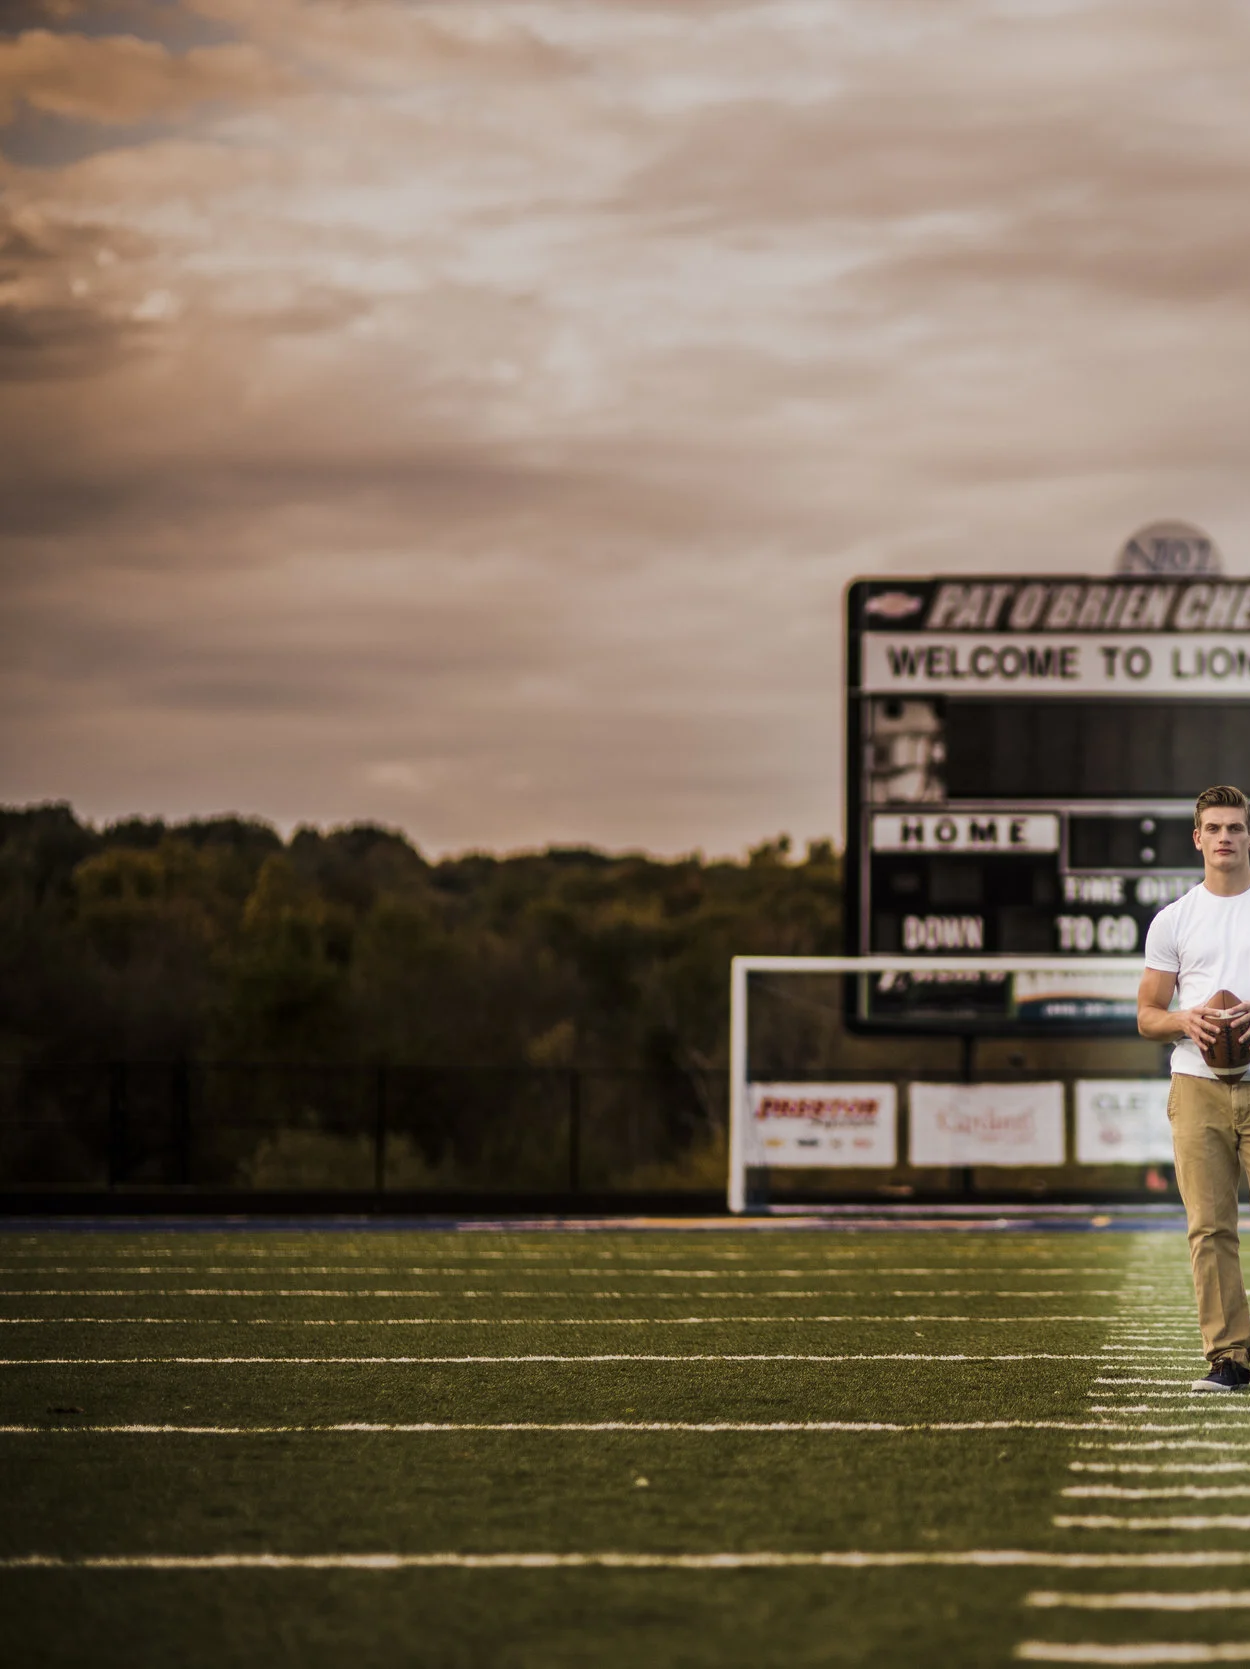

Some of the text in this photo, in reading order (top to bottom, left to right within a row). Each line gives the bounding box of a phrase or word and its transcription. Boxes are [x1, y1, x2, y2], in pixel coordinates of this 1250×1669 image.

[925, 584, 1014, 629] PAT
[1008, 584, 1175, 629] O'BRIEN
[887, 646, 1079, 679] WELCOME
[1102, 647, 1152, 679] TO
[899, 818, 1028, 844] HOME
[903, 915, 984, 950] DOWN
[1056, 915, 1138, 950] TO GO
